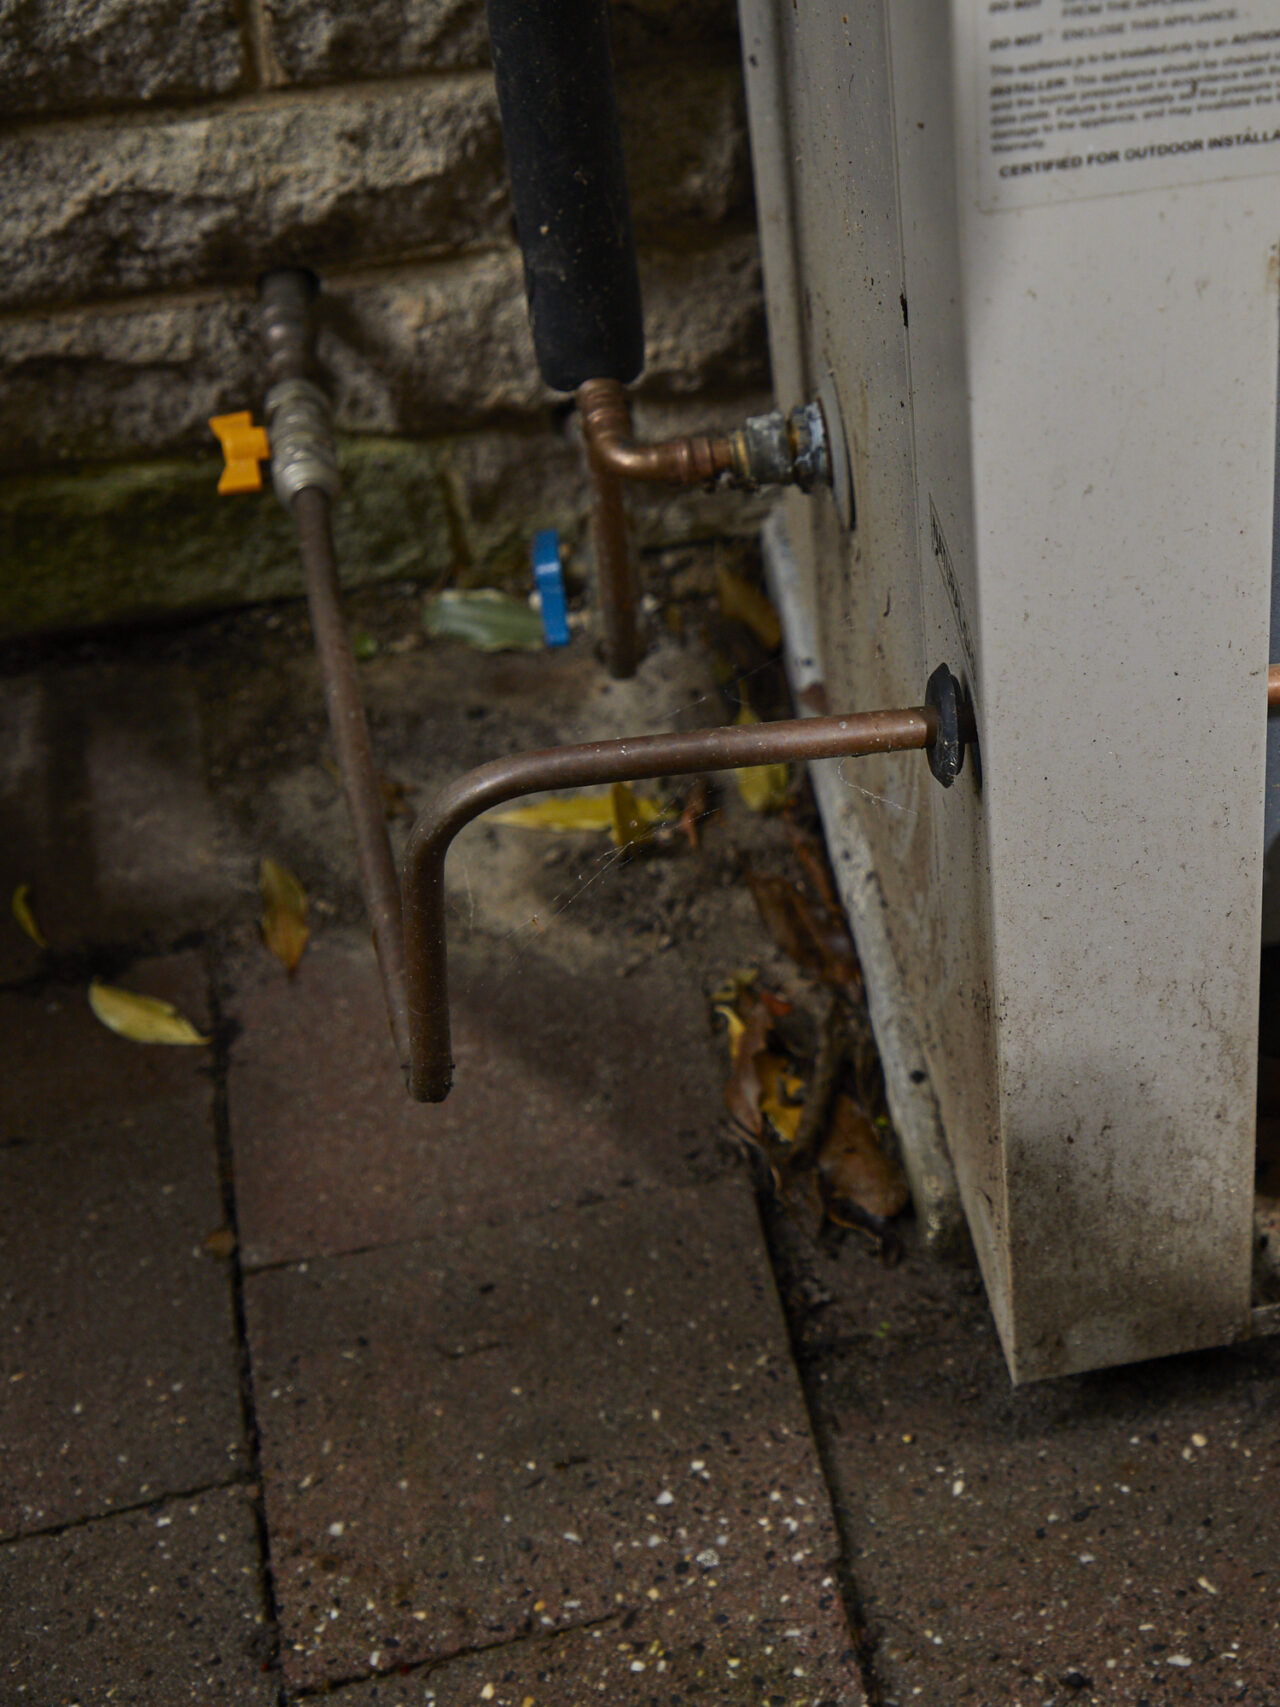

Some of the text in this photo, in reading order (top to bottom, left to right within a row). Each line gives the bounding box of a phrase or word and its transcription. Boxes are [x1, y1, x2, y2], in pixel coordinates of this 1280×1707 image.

[999, 154, 1083, 176] CERTIFIED
[1087, 149, 1120, 164] FOR
[1124, 138, 1203, 159] OUTDOOR
